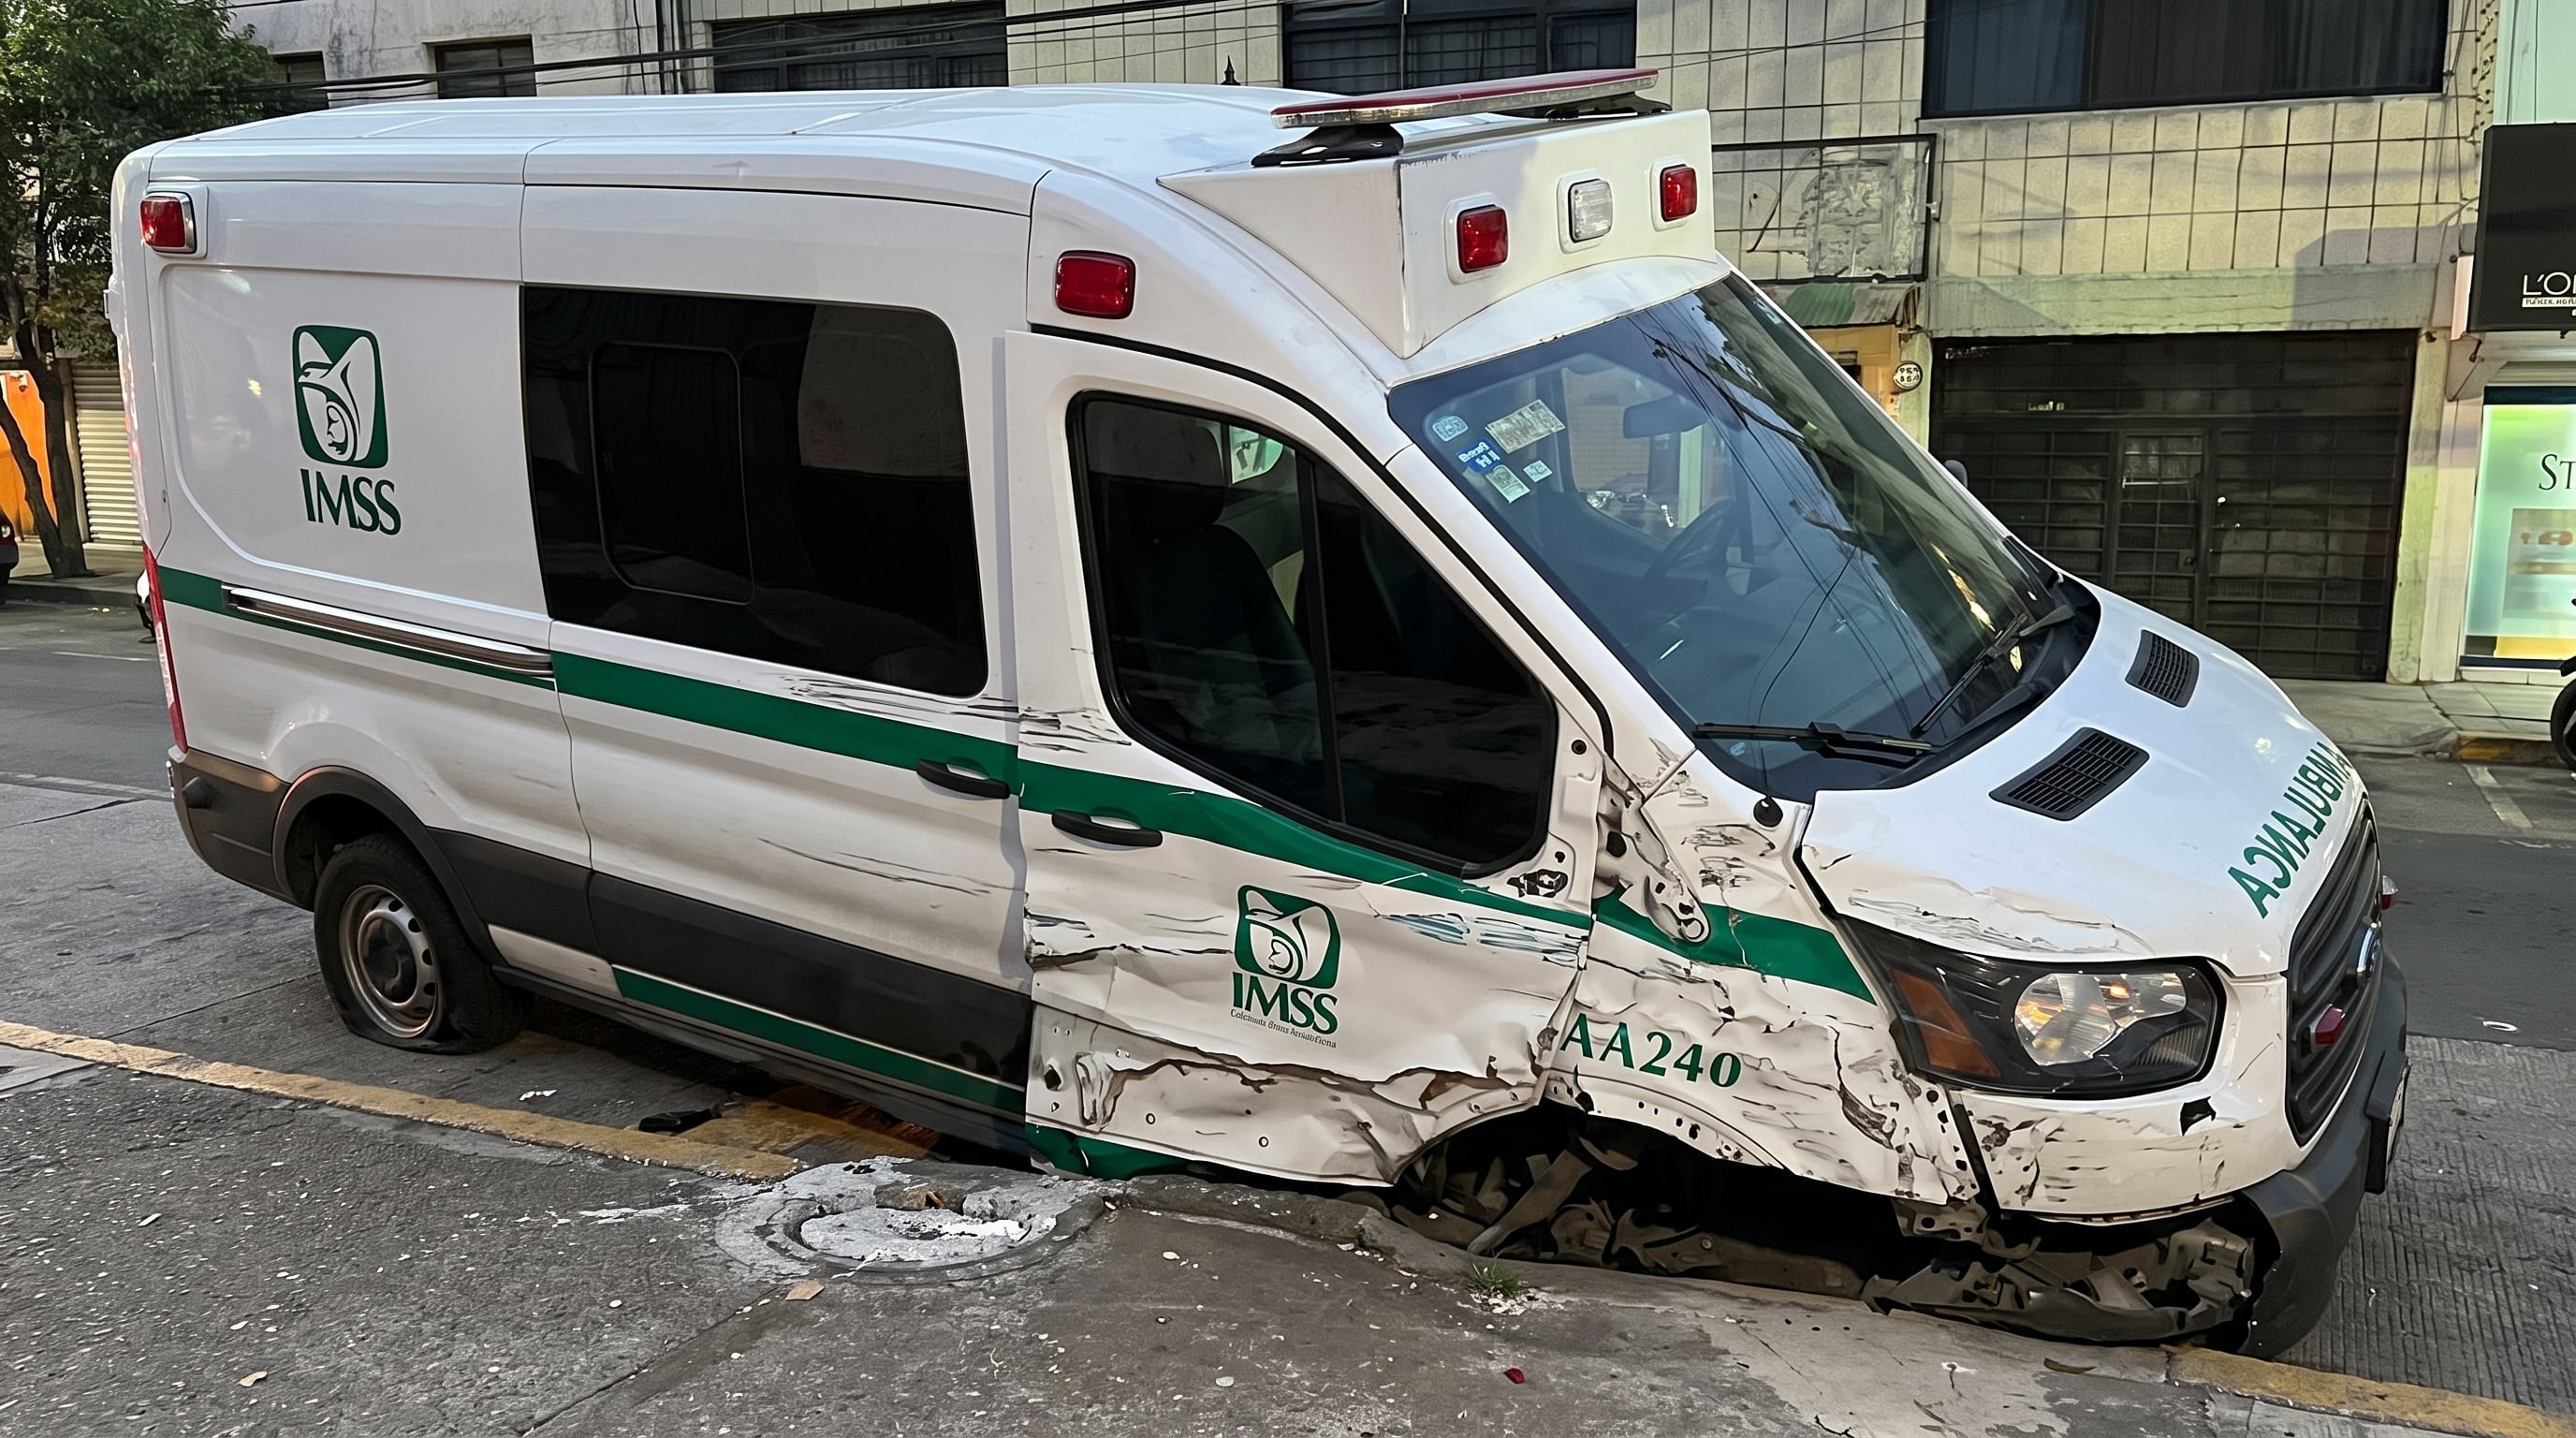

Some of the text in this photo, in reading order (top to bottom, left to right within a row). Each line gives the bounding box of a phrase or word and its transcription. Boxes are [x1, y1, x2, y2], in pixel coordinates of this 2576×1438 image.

[2523, 271, 2576, 296] L'O
[300, 468, 402, 536] IMSS
[1232, 971, 1339, 1035] IMSS
[1559, 1012, 1742, 1088] AA240
